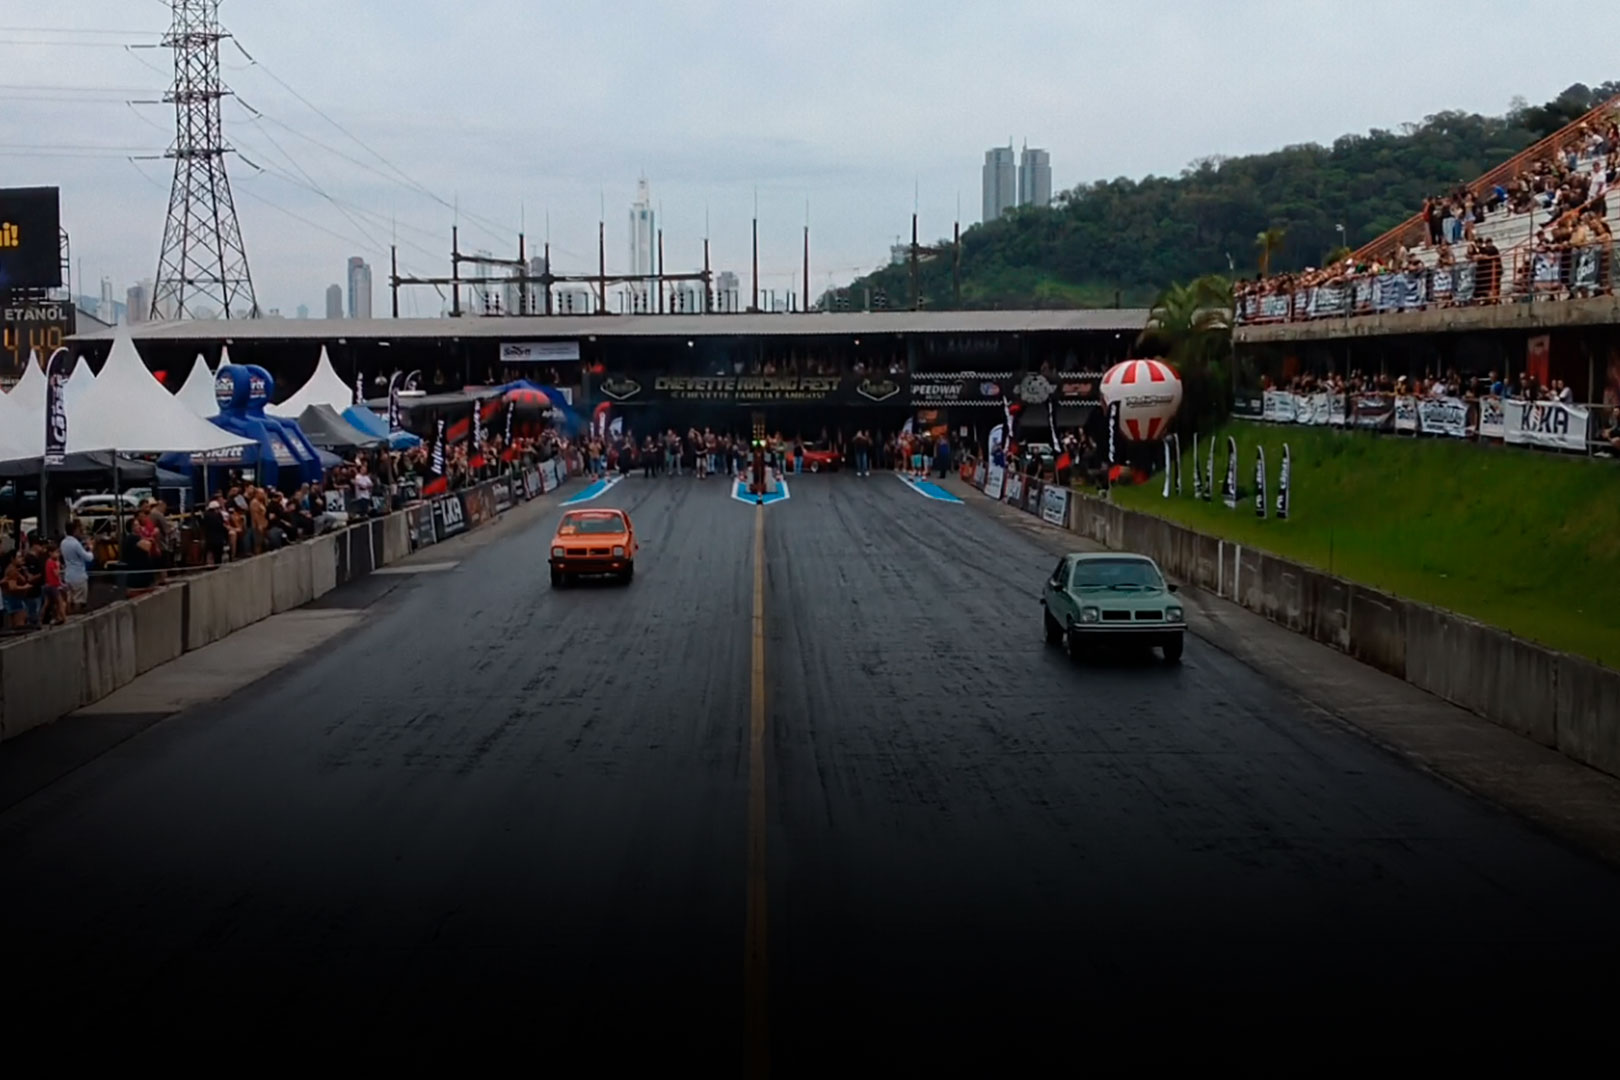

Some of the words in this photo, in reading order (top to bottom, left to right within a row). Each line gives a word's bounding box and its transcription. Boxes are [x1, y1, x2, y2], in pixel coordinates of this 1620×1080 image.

[5, 308, 67, 320] ETANOL
[655, 376, 735, 390] CHEVETTE
[800, 376, 842, 390] FEST
